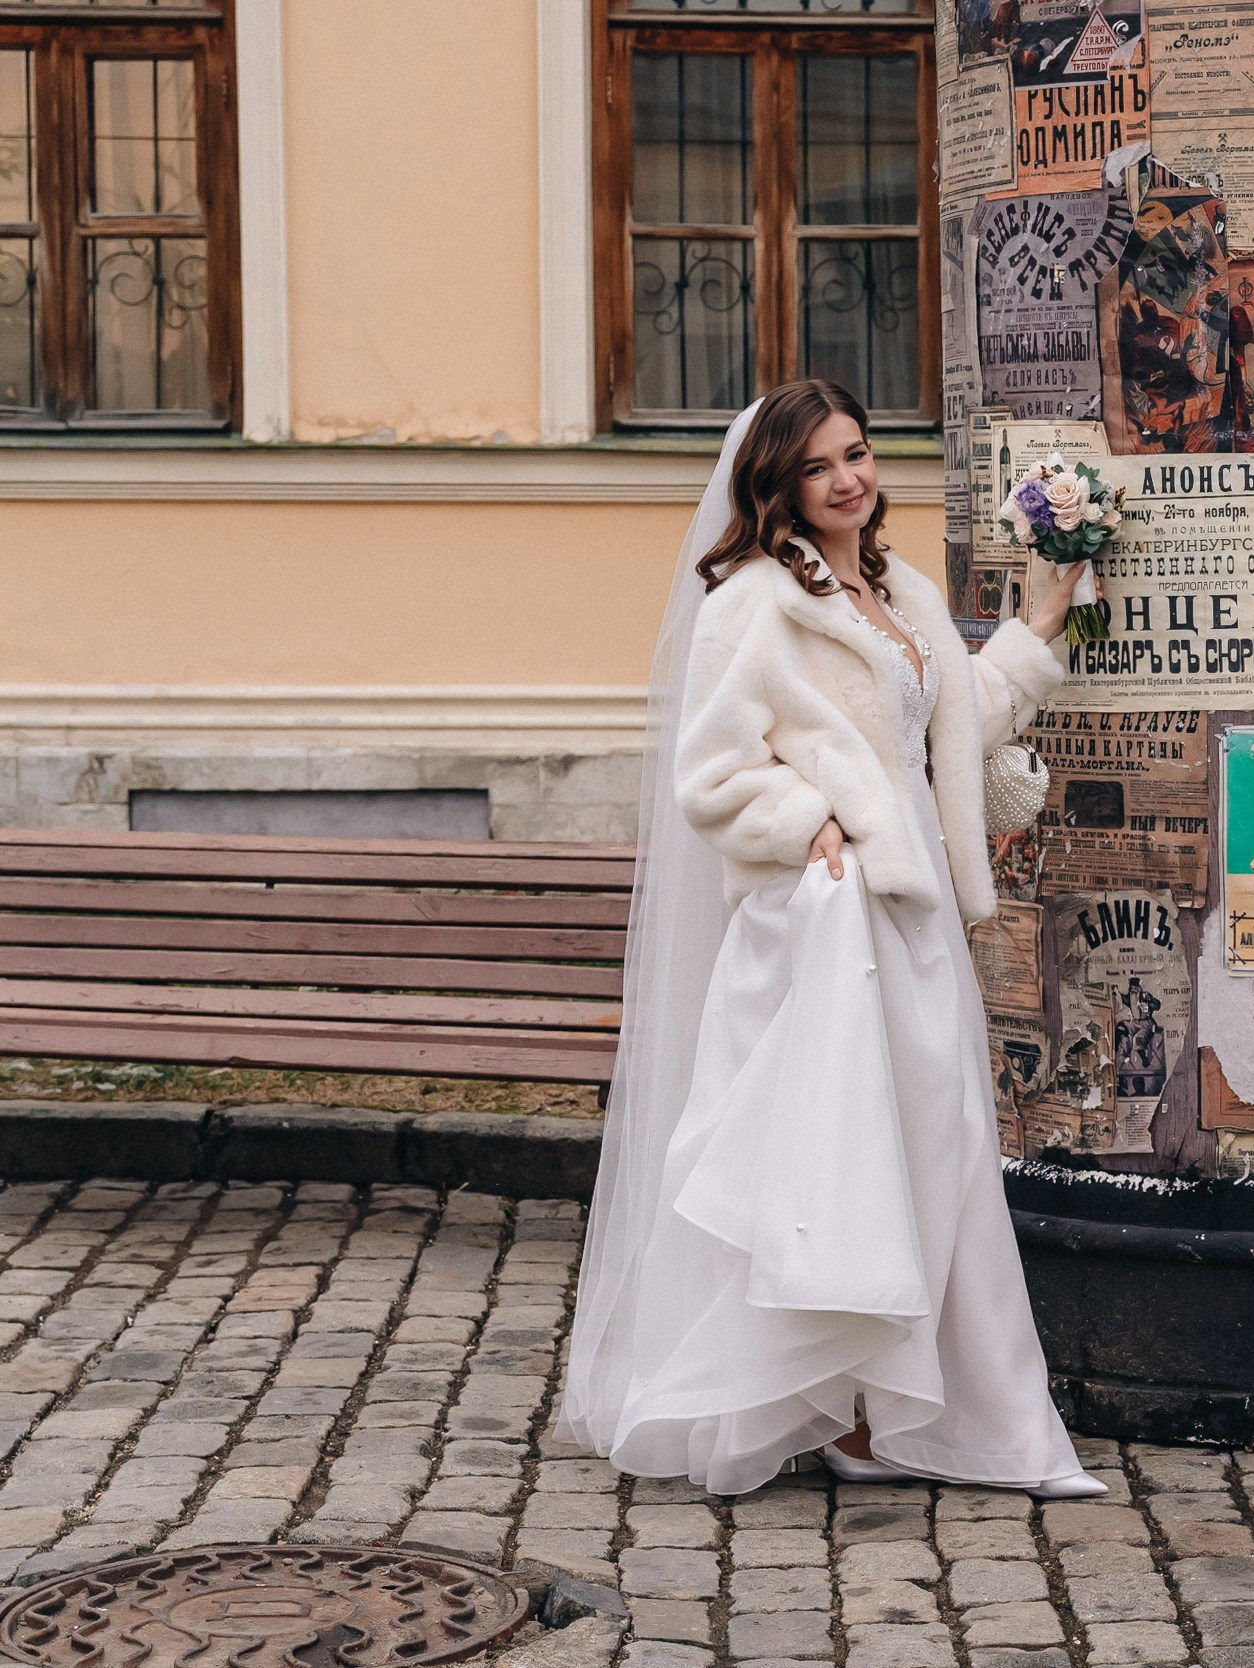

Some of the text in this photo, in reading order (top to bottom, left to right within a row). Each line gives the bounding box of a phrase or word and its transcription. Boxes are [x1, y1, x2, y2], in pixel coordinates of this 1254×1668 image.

[1204, 502, 1249, 522] ноября,
[1158, 580, 1248, 592] ПРЕДПОЛАГАЕТСЯ
[1069, 641, 1080, 674] И
[1086, 640, 1163, 674] БАЗАРЪ
[1168, 639, 1200, 674] СЪ
[1076, 900, 1174, 951] БЛИНЪ.
